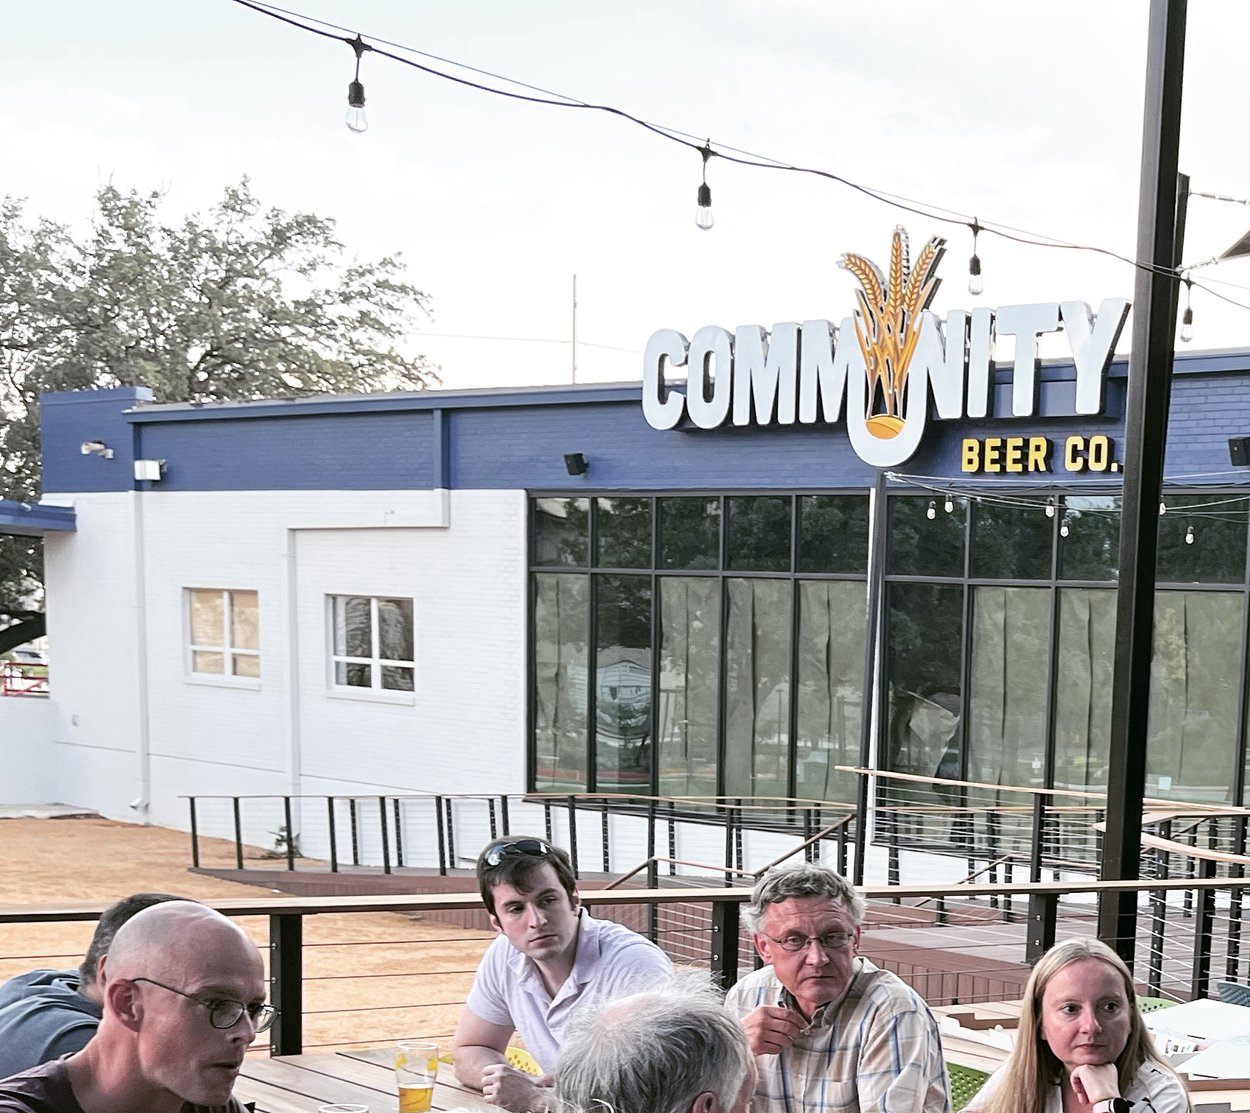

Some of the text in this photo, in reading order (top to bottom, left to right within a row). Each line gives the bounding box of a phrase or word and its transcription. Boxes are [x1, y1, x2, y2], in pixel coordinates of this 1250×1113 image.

[642, 298, 1132, 468] COMMUNITY
[961, 434, 1120, 473] BEER CO.
